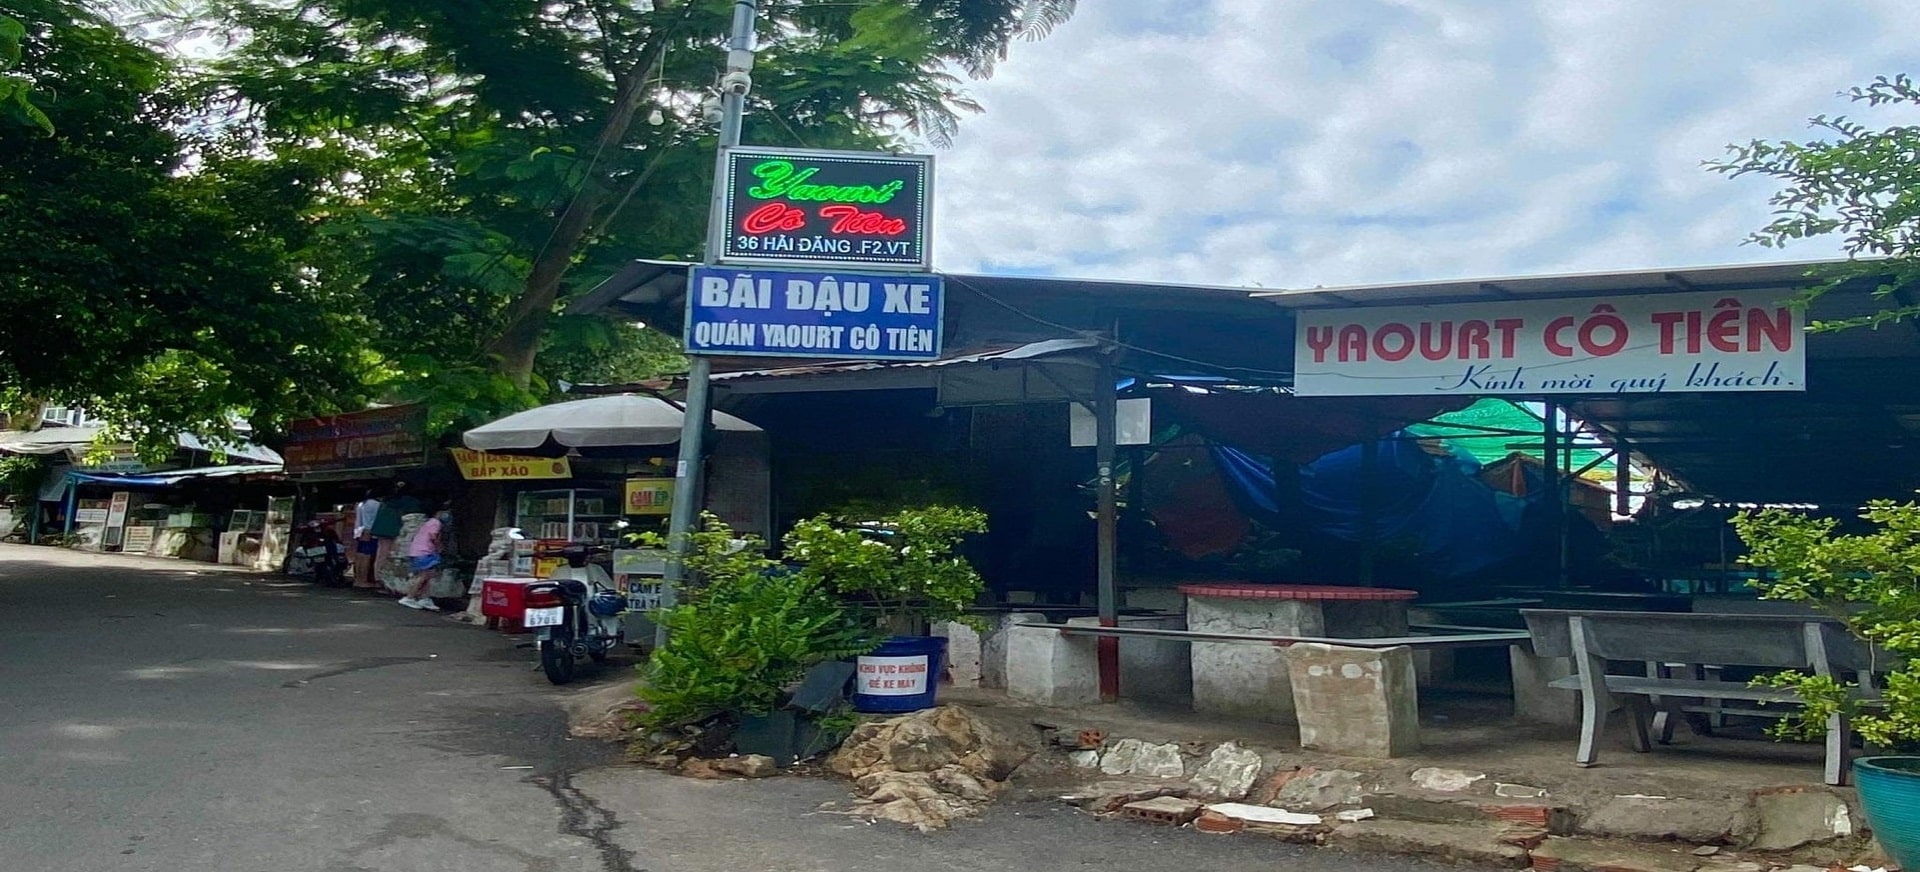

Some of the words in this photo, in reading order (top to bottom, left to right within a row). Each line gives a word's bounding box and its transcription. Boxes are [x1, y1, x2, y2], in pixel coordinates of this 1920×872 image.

[749, 161, 904, 203] Yaourt
[744, 203, 805, 233] Cô
[820, 205, 906, 235] Tiên
[737, 237, 759, 250] 36
[763, 234, 794, 251] HẢI
[797, 236, 851, 253] ĐĂNG
[701, 273, 772, 309] BÃI
[785, 275, 870, 317] ĐẬU
[882, 283, 931, 314] XE
[695, 319, 755, 346] QUÁN
[762, 323, 844, 349] YAOURT
[850, 323, 880, 350] CÔ
[886, 324, 933, 352] TIÊN
[1306, 318, 1525, 363] YAOURT
[1543, 303, 1630, 357] CÔ
[1650, 297, 1793, 354] TIÊN
[1434, 364, 1526, 390] Kính
[1540, 374, 1595, 389] mời
[1610, 372, 1669, 393] quý
[860, 664, 876, 673] KHU
[884, 680, 894, 688] XE
